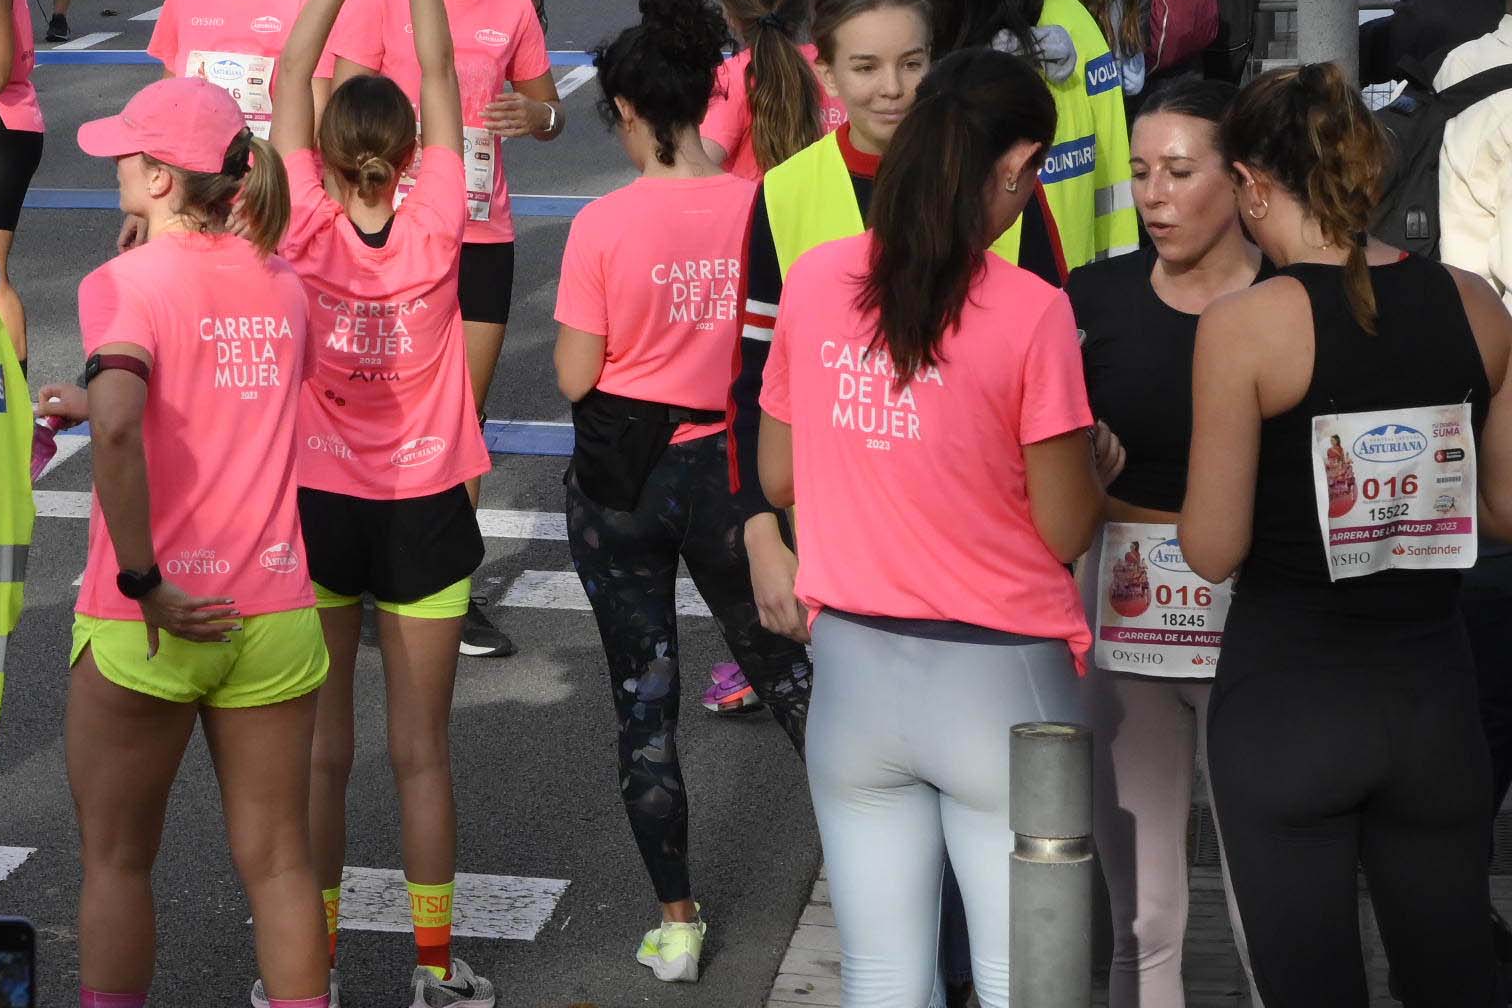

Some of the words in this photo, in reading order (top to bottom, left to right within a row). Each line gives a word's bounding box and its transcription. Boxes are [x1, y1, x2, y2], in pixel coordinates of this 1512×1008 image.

[651, 258, 741, 285] CARRER
[672, 282, 702, 303] DE
[710, 280, 738, 299] LA
[318, 293, 429, 317] CARRERA
[200, 315, 293, 340] CARRERA
[334, 314, 367, 336] DE
[378, 318, 409, 337] LA
[217, 342, 242, 363] DE
[250, 341, 277, 362] LA
[326, 331, 414, 355] MUJER
[359, 357, 382, 365] 2023
[820, 340, 944, 387] CARRRA
[214, 364, 280, 387] MUJER
[839, 374, 873, 404] DE
[884, 380, 917, 411] LA
[832, 402, 922, 441] MUJER
[1432, 427, 1461, 438] SUMA
[866, 438, 891, 451] 2023
[1358, 441, 1423, 456] ASTURIANA
[1362, 474, 1419, 501] 016
[1369, 503, 1410, 522] 15522
[1372, 529, 1385, 539] DE
[1386, 527, 1396, 536] LA
[1397, 524, 1432, 534] MUJER
[1435, 522, 1458, 531] 2023
[1407, 543, 1462, 557] Santander
[166, 559, 230, 574] OYSHO
[1155, 584, 1212, 608] 016
[1161, 613, 1205, 627] 18245
[1118, 631, 1163, 642] CARRERA
[1164, 632, 1179, 642] DE
[1180, 632, 1193, 642] LA
[1195, 633, 1222, 644] MUJE
[1112, 649, 1164, 664] OYSHO
